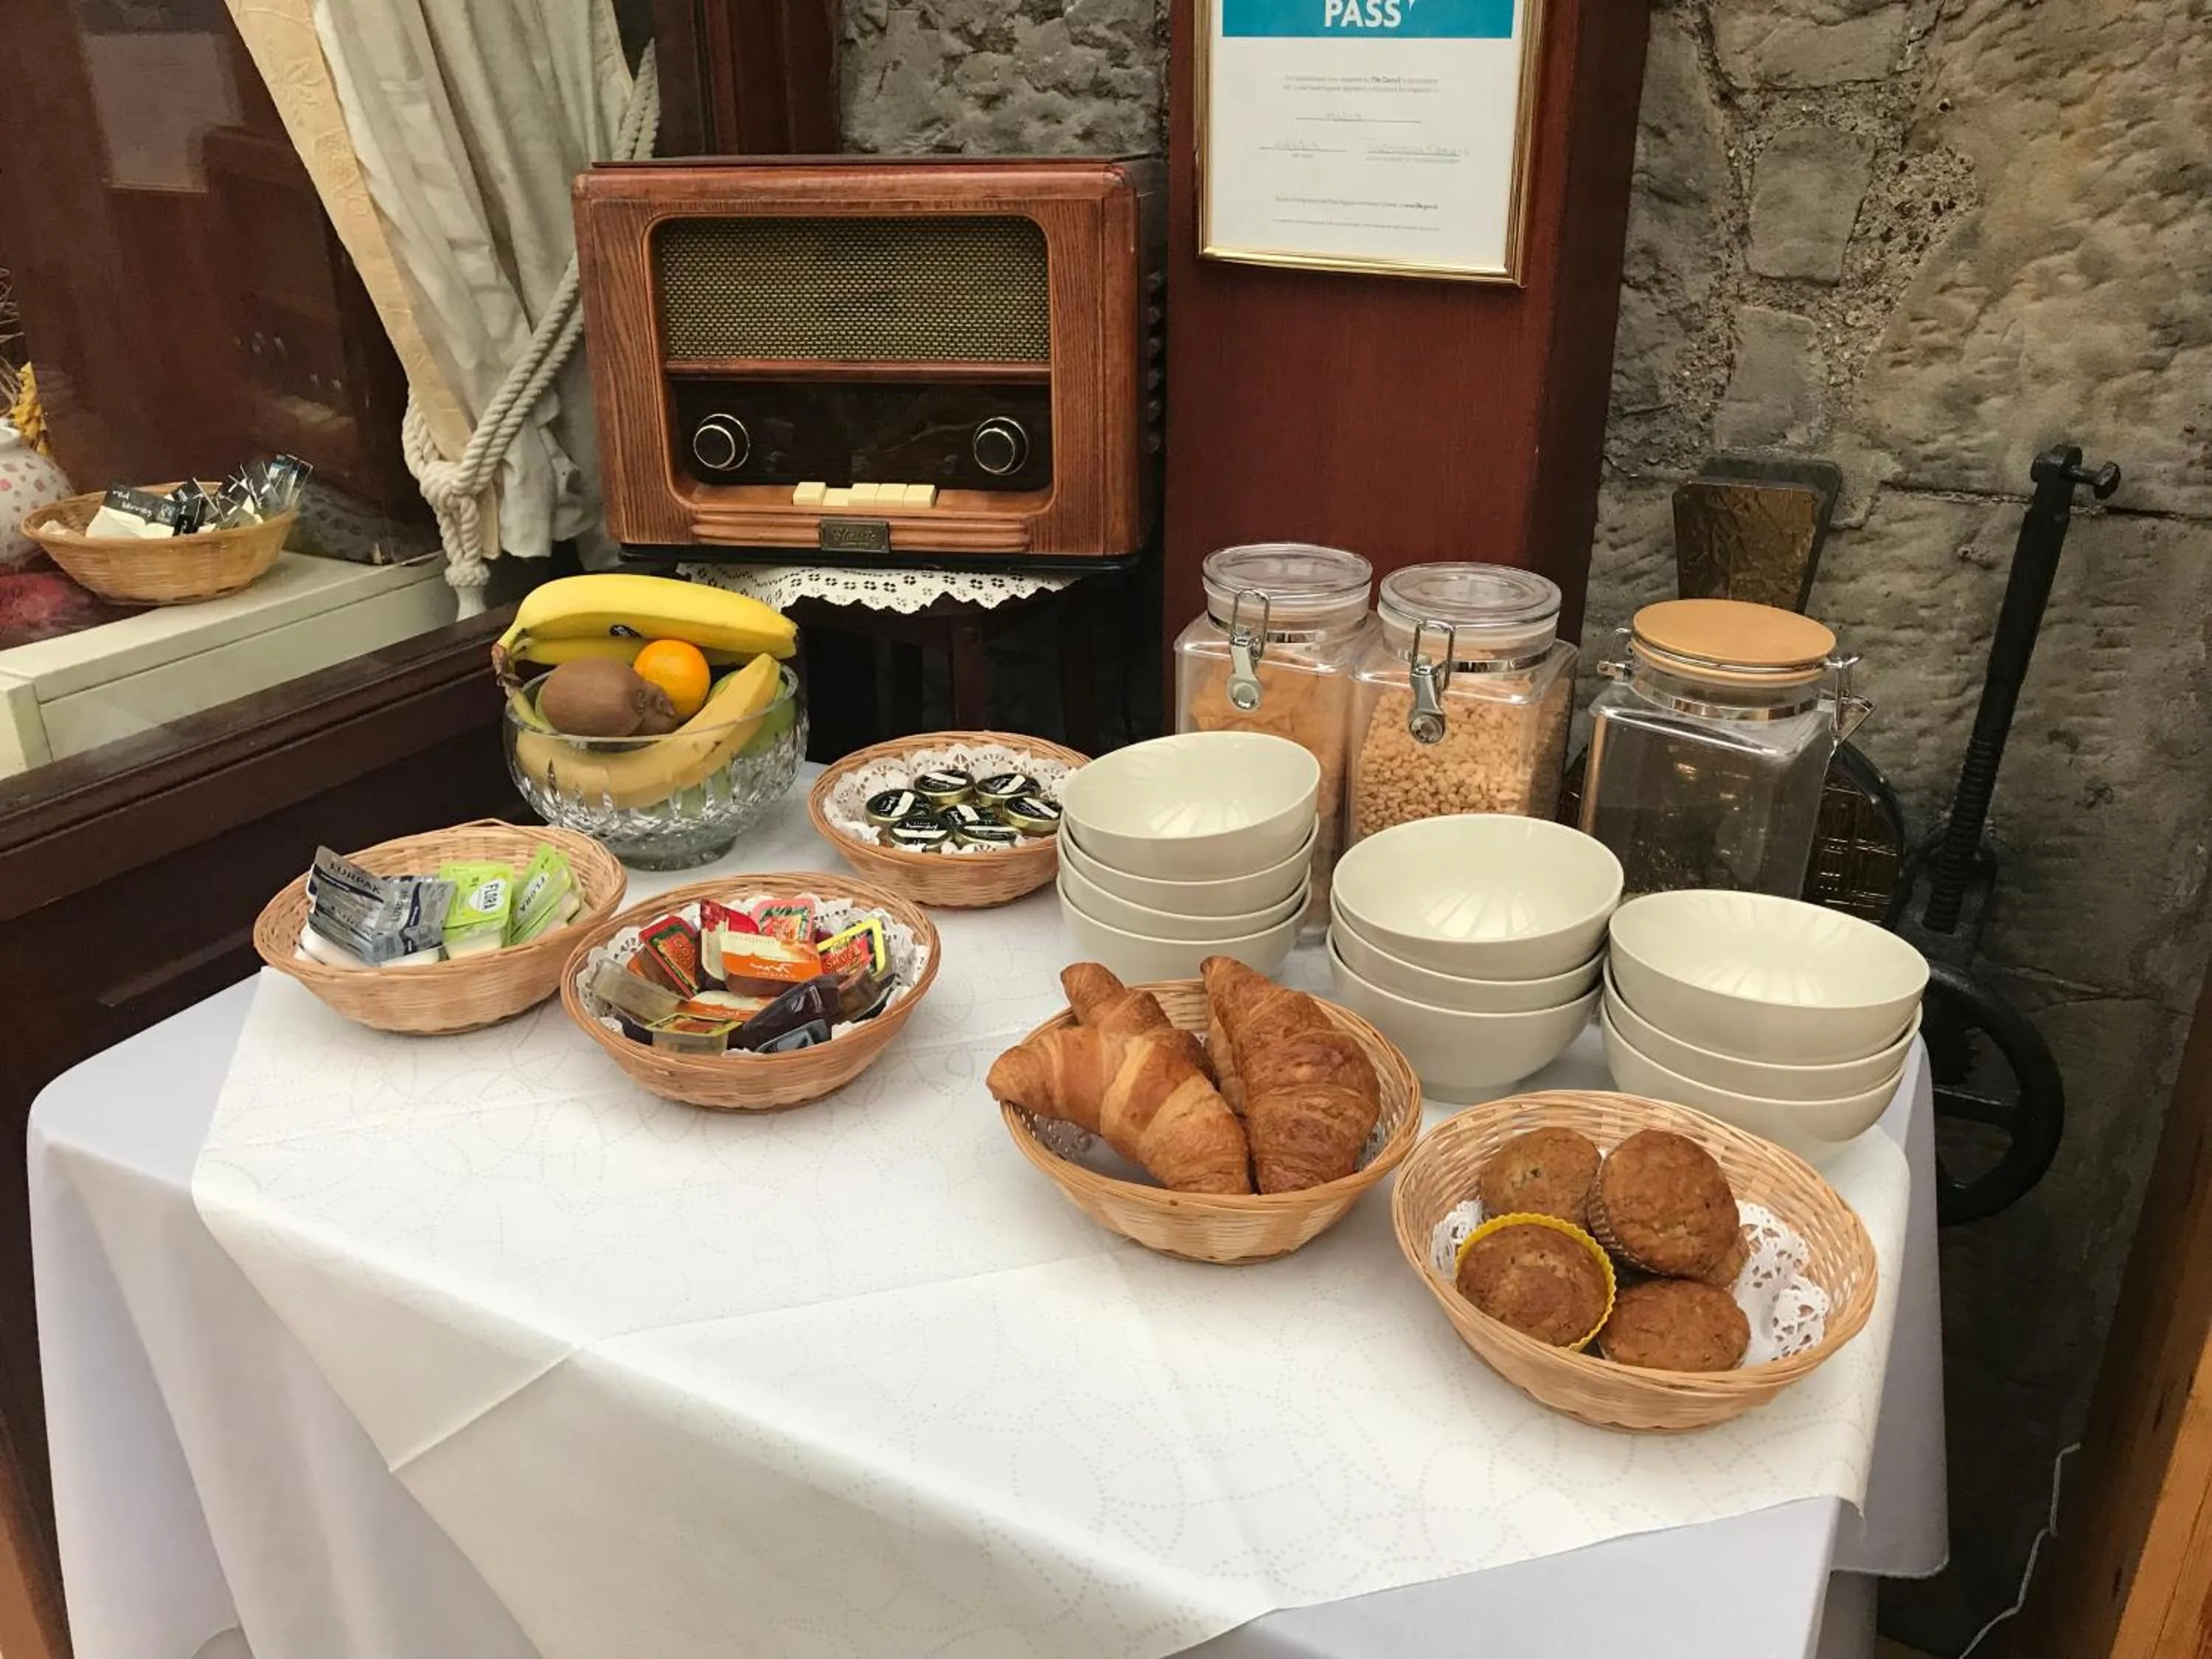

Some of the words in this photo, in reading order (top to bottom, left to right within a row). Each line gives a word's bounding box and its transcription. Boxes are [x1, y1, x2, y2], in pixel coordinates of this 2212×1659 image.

[1324, 0, 1402, 28] PASS
[329, 862, 381, 895] LURPAK
[518, 875, 546, 913] FLORA
[481, 880, 502, 911] FLORA
